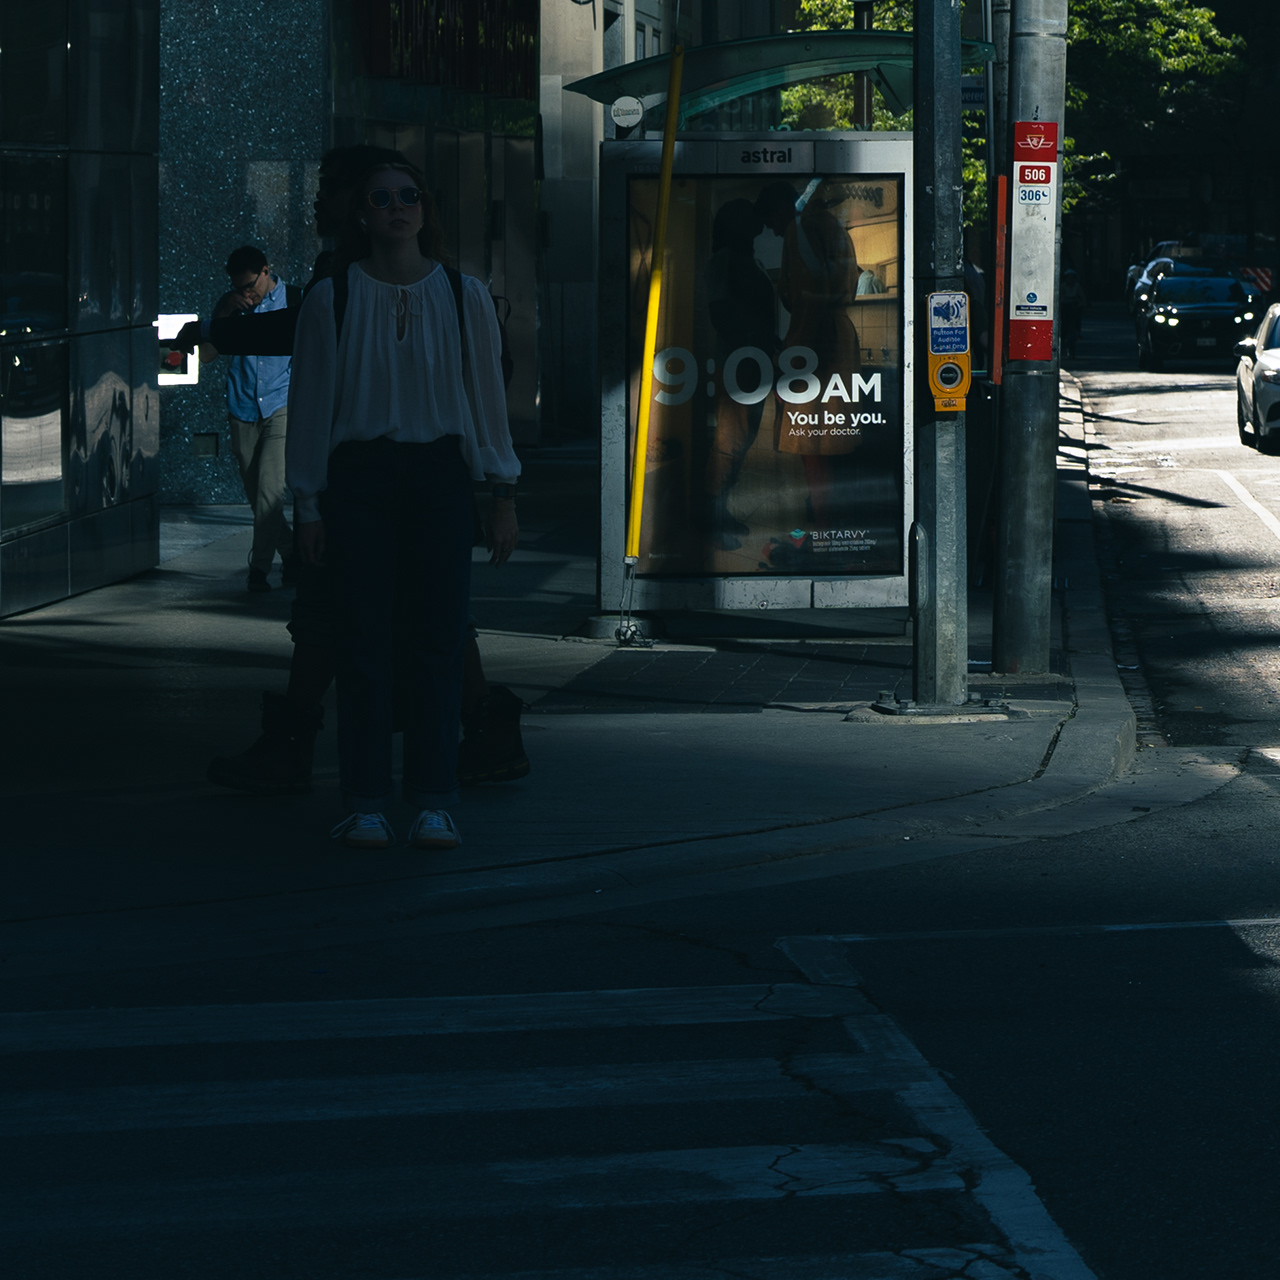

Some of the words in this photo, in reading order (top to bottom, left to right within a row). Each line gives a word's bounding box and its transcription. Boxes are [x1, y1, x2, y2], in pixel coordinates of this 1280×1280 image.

[741, 147, 792, 164] astral
[1024, 168, 1046, 181] 506
[1020, 189, 1041, 201] 306
[787, 411, 819, 426] You
[823, 410, 846, 425] be
[850, 412, 887, 427] you.
[788, 428, 806, 437] Ask
[807, 428, 828, 438] your
[830, 426, 861, 436] doctor.
[812, 530, 867, 540] BIKTARVY
